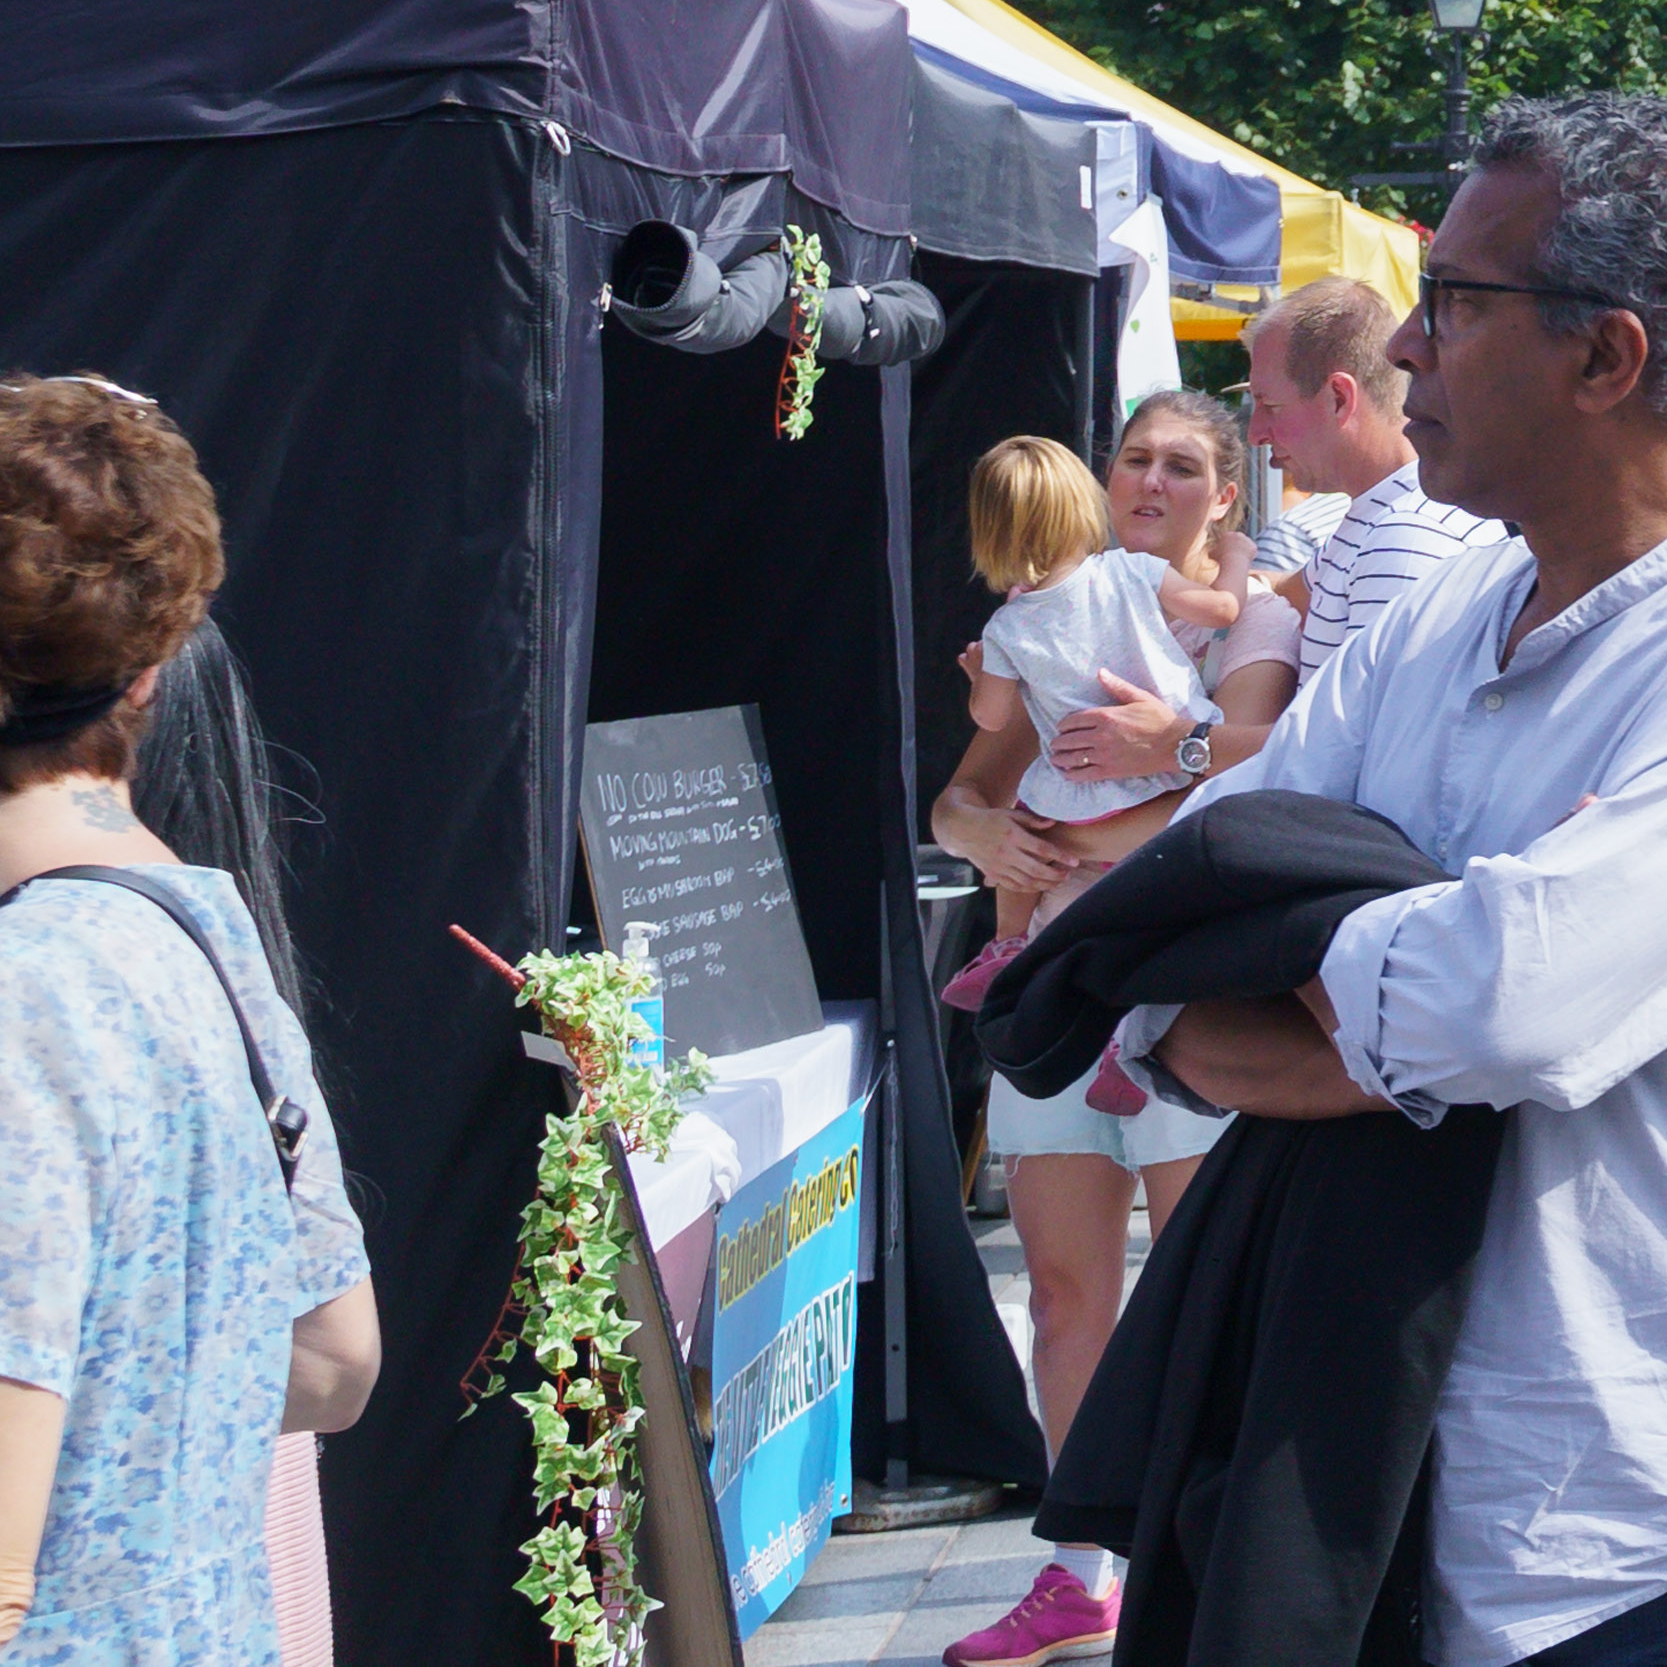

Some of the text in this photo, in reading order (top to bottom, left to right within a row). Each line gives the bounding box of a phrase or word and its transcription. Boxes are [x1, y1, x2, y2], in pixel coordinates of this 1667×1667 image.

[597, 774, 628, 813] NO
[673, 764, 728, 800] BURGER
[718, 1186, 788, 1314] Cathedral
[786, 1155, 842, 1257] Catering
